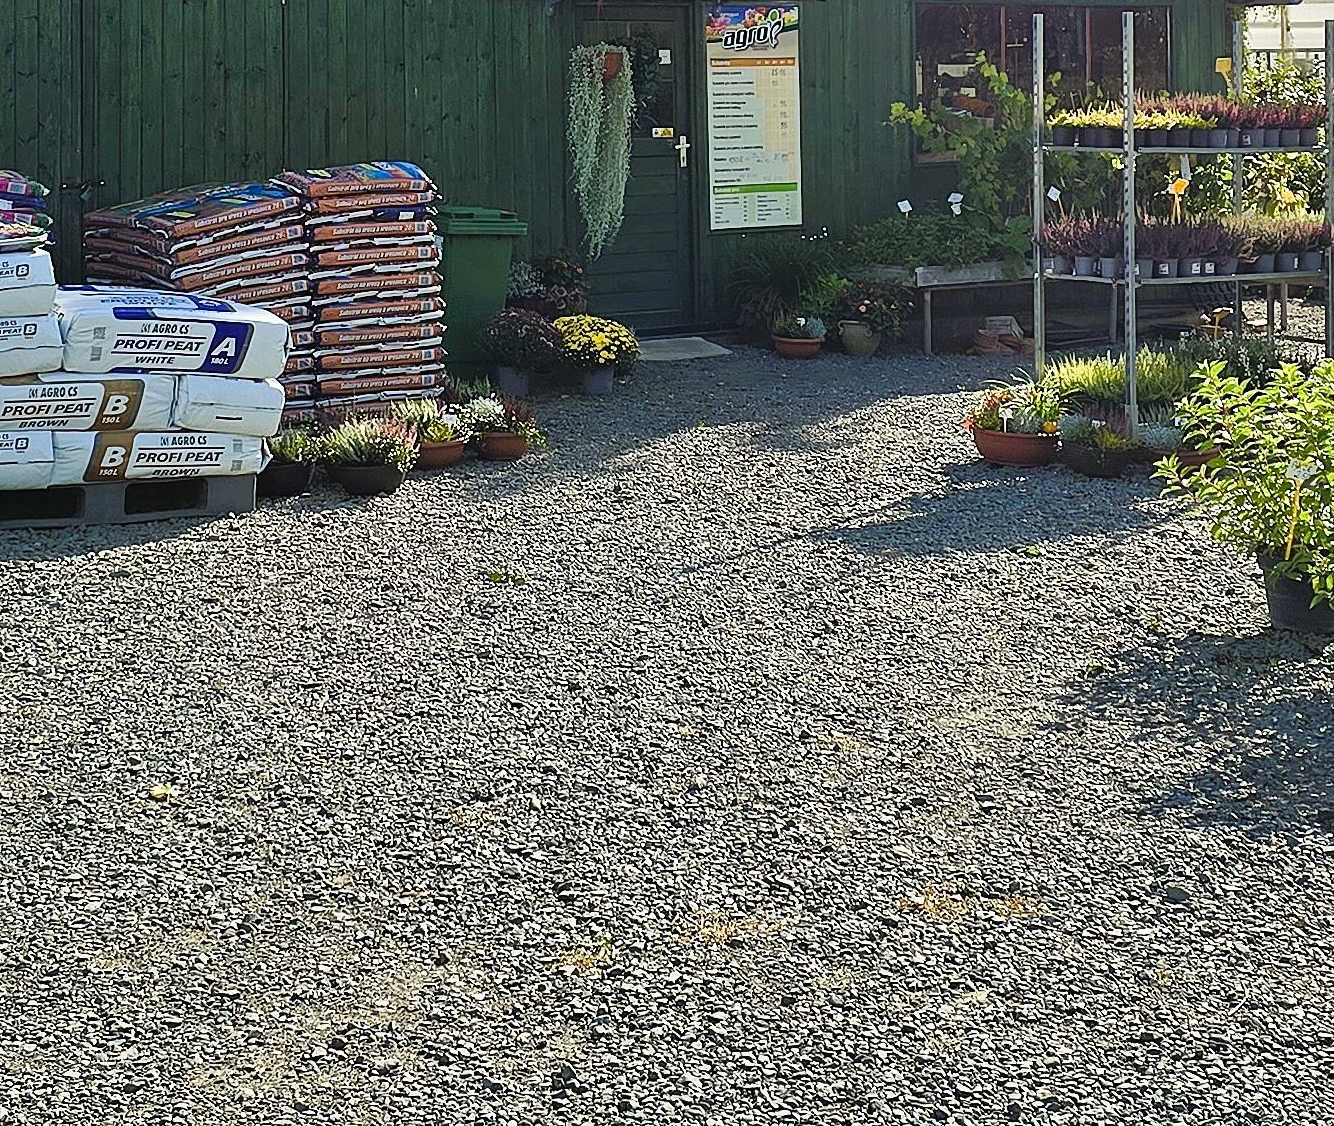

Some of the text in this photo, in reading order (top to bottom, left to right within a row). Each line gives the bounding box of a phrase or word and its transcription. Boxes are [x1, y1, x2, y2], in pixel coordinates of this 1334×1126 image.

[722, 24, 770, 51] agro
[151, 323, 190, 335] AGRO CS
[114, 339, 204, 352] PROFI PEAT
[210, 336, 236, 357] A
[134, 356, 176, 365] WHITE
[40, 386, 78, 398] AGRO CS
[1, 402, 94, 417] PROFI PEAT
[103, 394, 129, 415] B
[18, 419, 68, 429] BROWN
[171, 436, 207, 446] AGRO CS
[100, 447, 126, 467] B
[135, 452, 223, 463] PROFI PEAT
